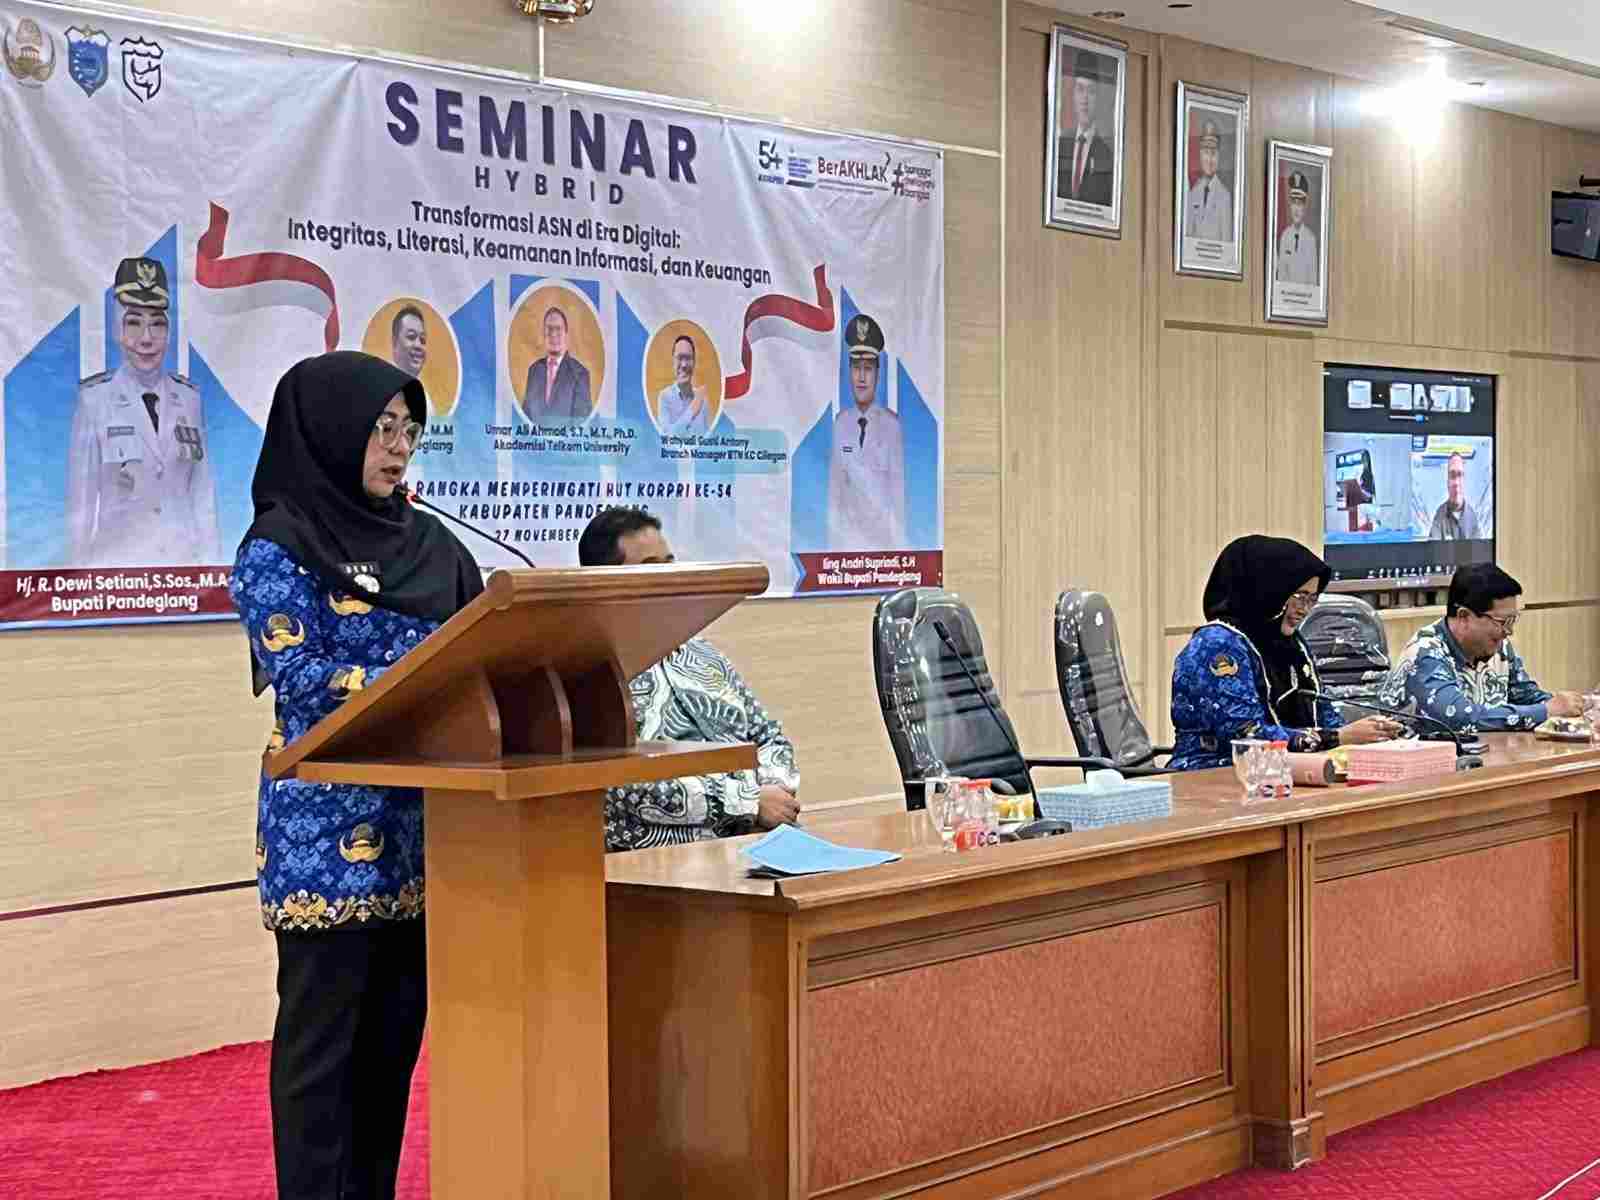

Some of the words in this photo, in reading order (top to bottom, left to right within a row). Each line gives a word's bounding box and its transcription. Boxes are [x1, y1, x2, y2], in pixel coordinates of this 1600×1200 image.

[385, 81, 697, 184] SEMINAR
[818, 155, 888, 183] BerAKHLAK
[475, 166, 624, 204] HYBRID
[411, 201, 533, 234] Transformasi
[538, 215, 570, 238] ASN
[576, 218, 592, 239] di
[596, 222, 618, 242] Era
[624, 224, 680, 250] Digital:
[288, 218, 392, 251] Integritas,
[398, 227, 469, 259] Literasi,
[473, 237, 570, 266] Keamanan
[576, 246, 657, 276] Informasi,
[662, 256, 691, 277] dan
[695, 259, 771, 288] Keuangan
[416, 481, 480, 497] RANGKA
[488, 481, 600, 498] MEMPERINGATI
[607, 481, 632, 498] HUT
[637, 482, 690, 498] KORPRI
[695, 482, 732, 498] KE-54
[460, 504, 549, 520] KABUPATEN
[515, 529, 579, 541] NOVEMBER
[16, 577, 35, 598] Hj.
[37, 576, 52, 592] R.
[55, 574, 92, 591] Dewi
[51, 594, 104, 616] Bupati
[107, 593, 199, 613] Pandeglang
